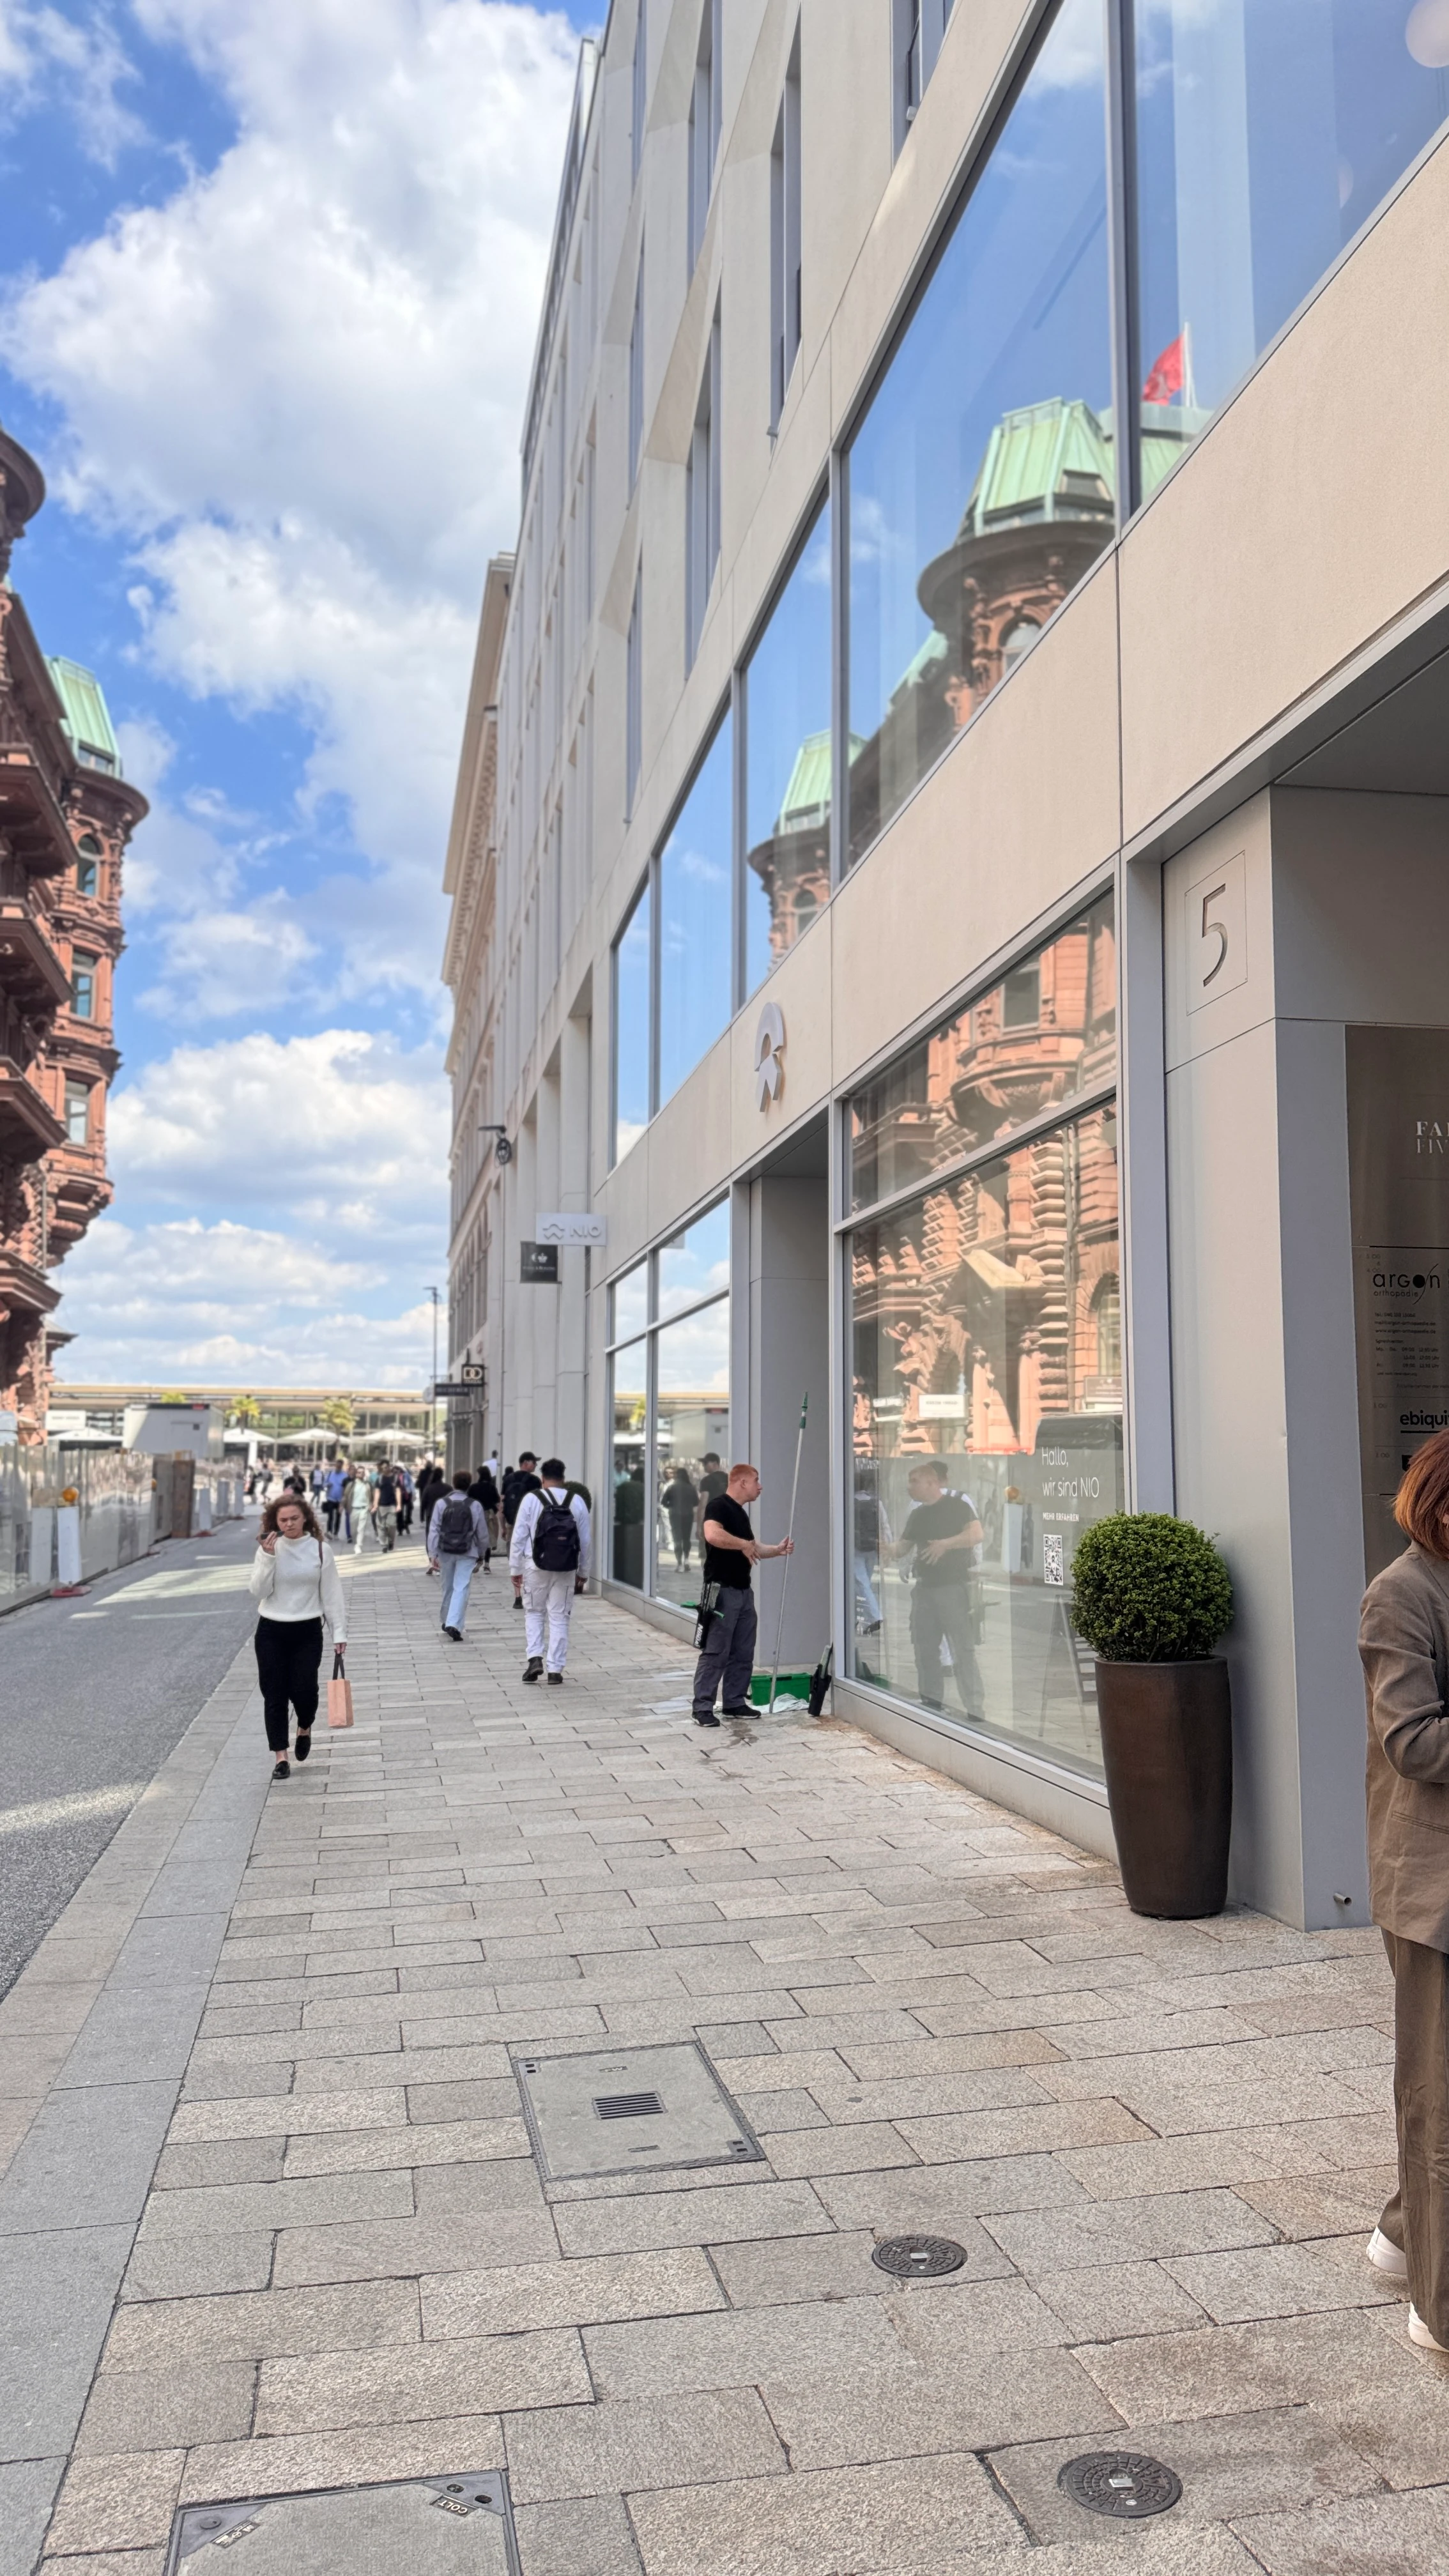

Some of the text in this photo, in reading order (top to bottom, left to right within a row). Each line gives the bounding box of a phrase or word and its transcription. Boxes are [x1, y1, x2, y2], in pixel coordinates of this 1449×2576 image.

[1202, 884, 1228, 987] 5
[570, 1225, 601, 1238] NIO
[1041, 1446, 1069, 1468] Hallo,
[1042, 1476, 1100, 1498] wir sind NIO
[1042, 1512, 1079, 1522] MEHR ERFAHREN
[438, 2500, 468, 2514] COLT
